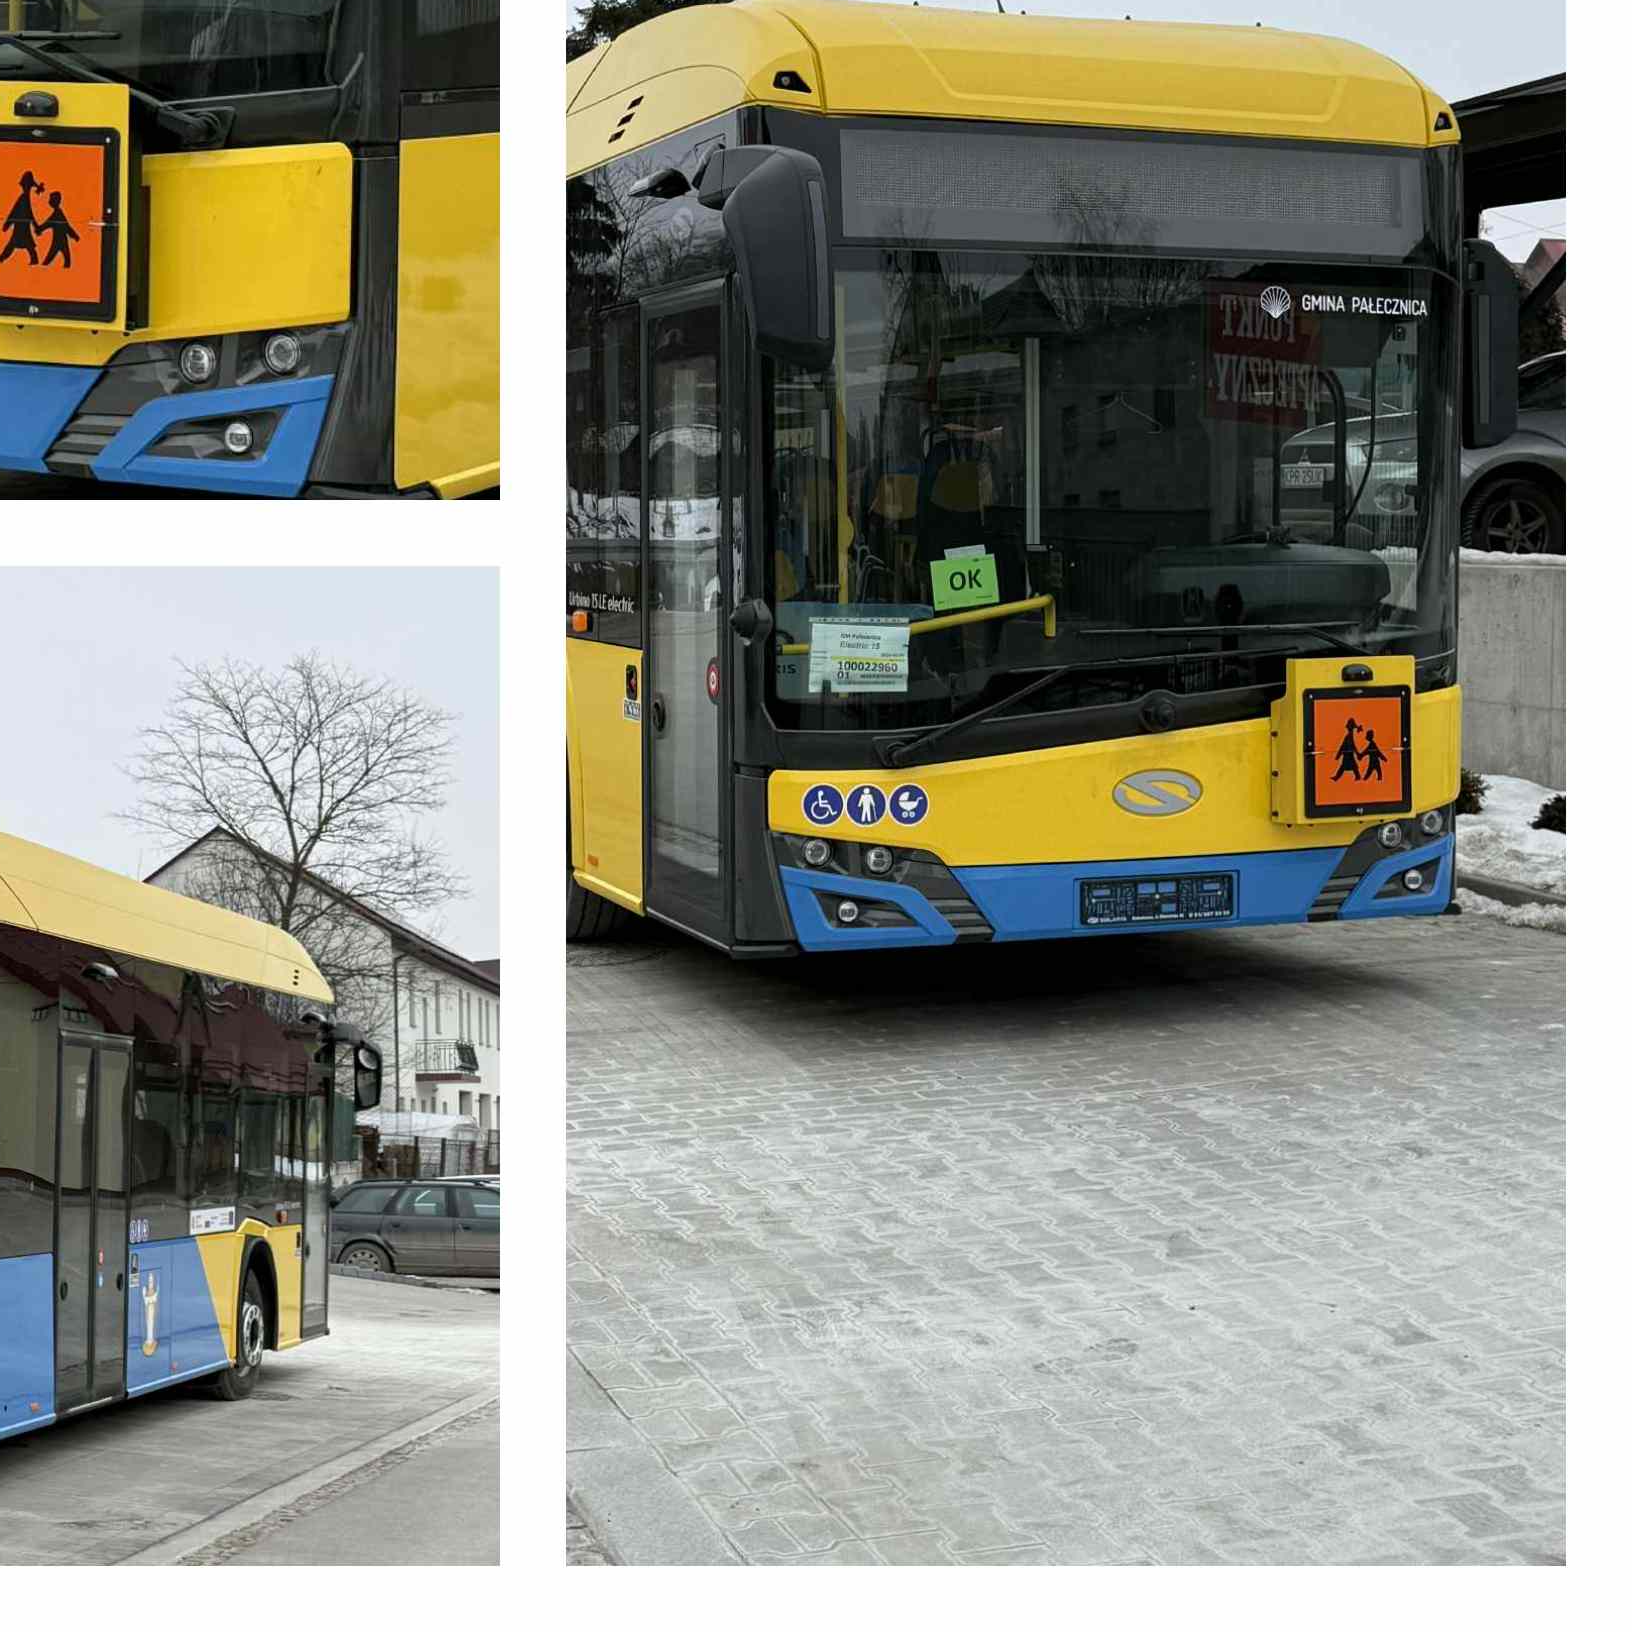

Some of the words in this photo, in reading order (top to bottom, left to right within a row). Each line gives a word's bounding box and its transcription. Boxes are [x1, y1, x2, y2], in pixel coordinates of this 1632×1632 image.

[1301, 294, 1345, 313] GMINA
[1351, 296, 1429, 317] PAŁECZNICA
[949, 569, 983, 592] OK
[568, 591, 591, 608] Urbino
[591, 592, 598, 609] 15
[599, 593, 607, 610] LE
[608, 595, 635, 614] electric
